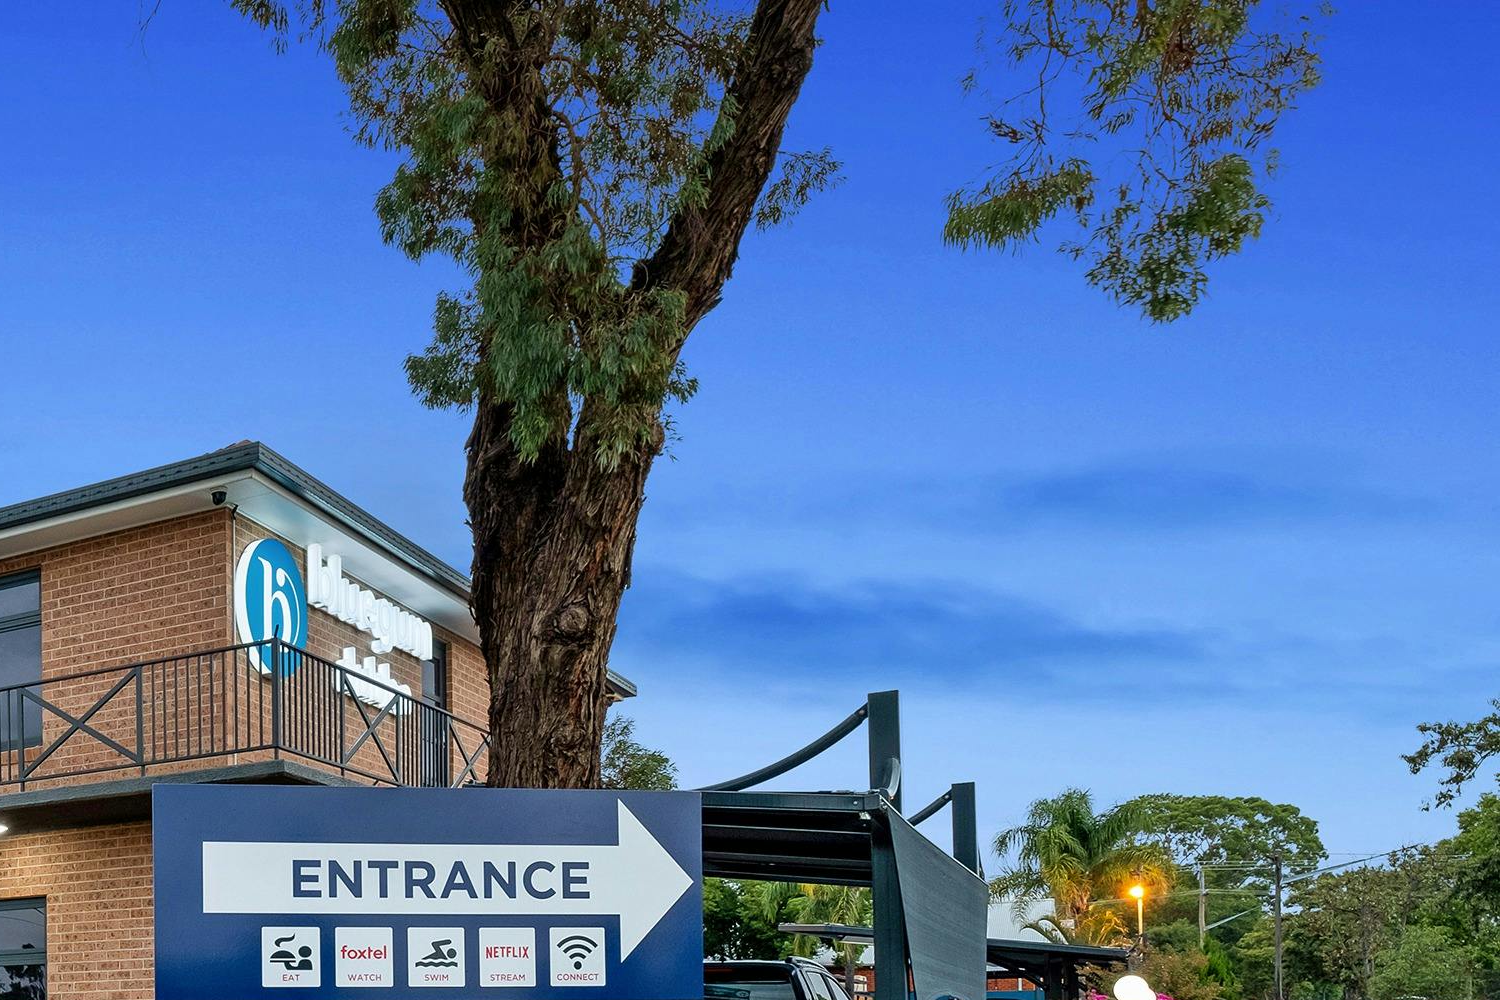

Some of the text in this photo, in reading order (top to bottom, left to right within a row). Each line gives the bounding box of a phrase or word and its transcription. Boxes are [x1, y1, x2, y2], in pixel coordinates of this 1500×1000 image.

[307, 543, 433, 661] bluegum
[292, 859, 591, 900] ENTRANCE
[340, 944, 388, 961] foxtel
[485, 945, 530, 960] NETFLIX
[282, 973, 301, 982] EAT
[347, 973, 382, 982] WATCH
[424, 973, 450, 982] SWIM
[490, 973, 526, 982] STREAM
[556, 972, 599, 982] CONNECT
